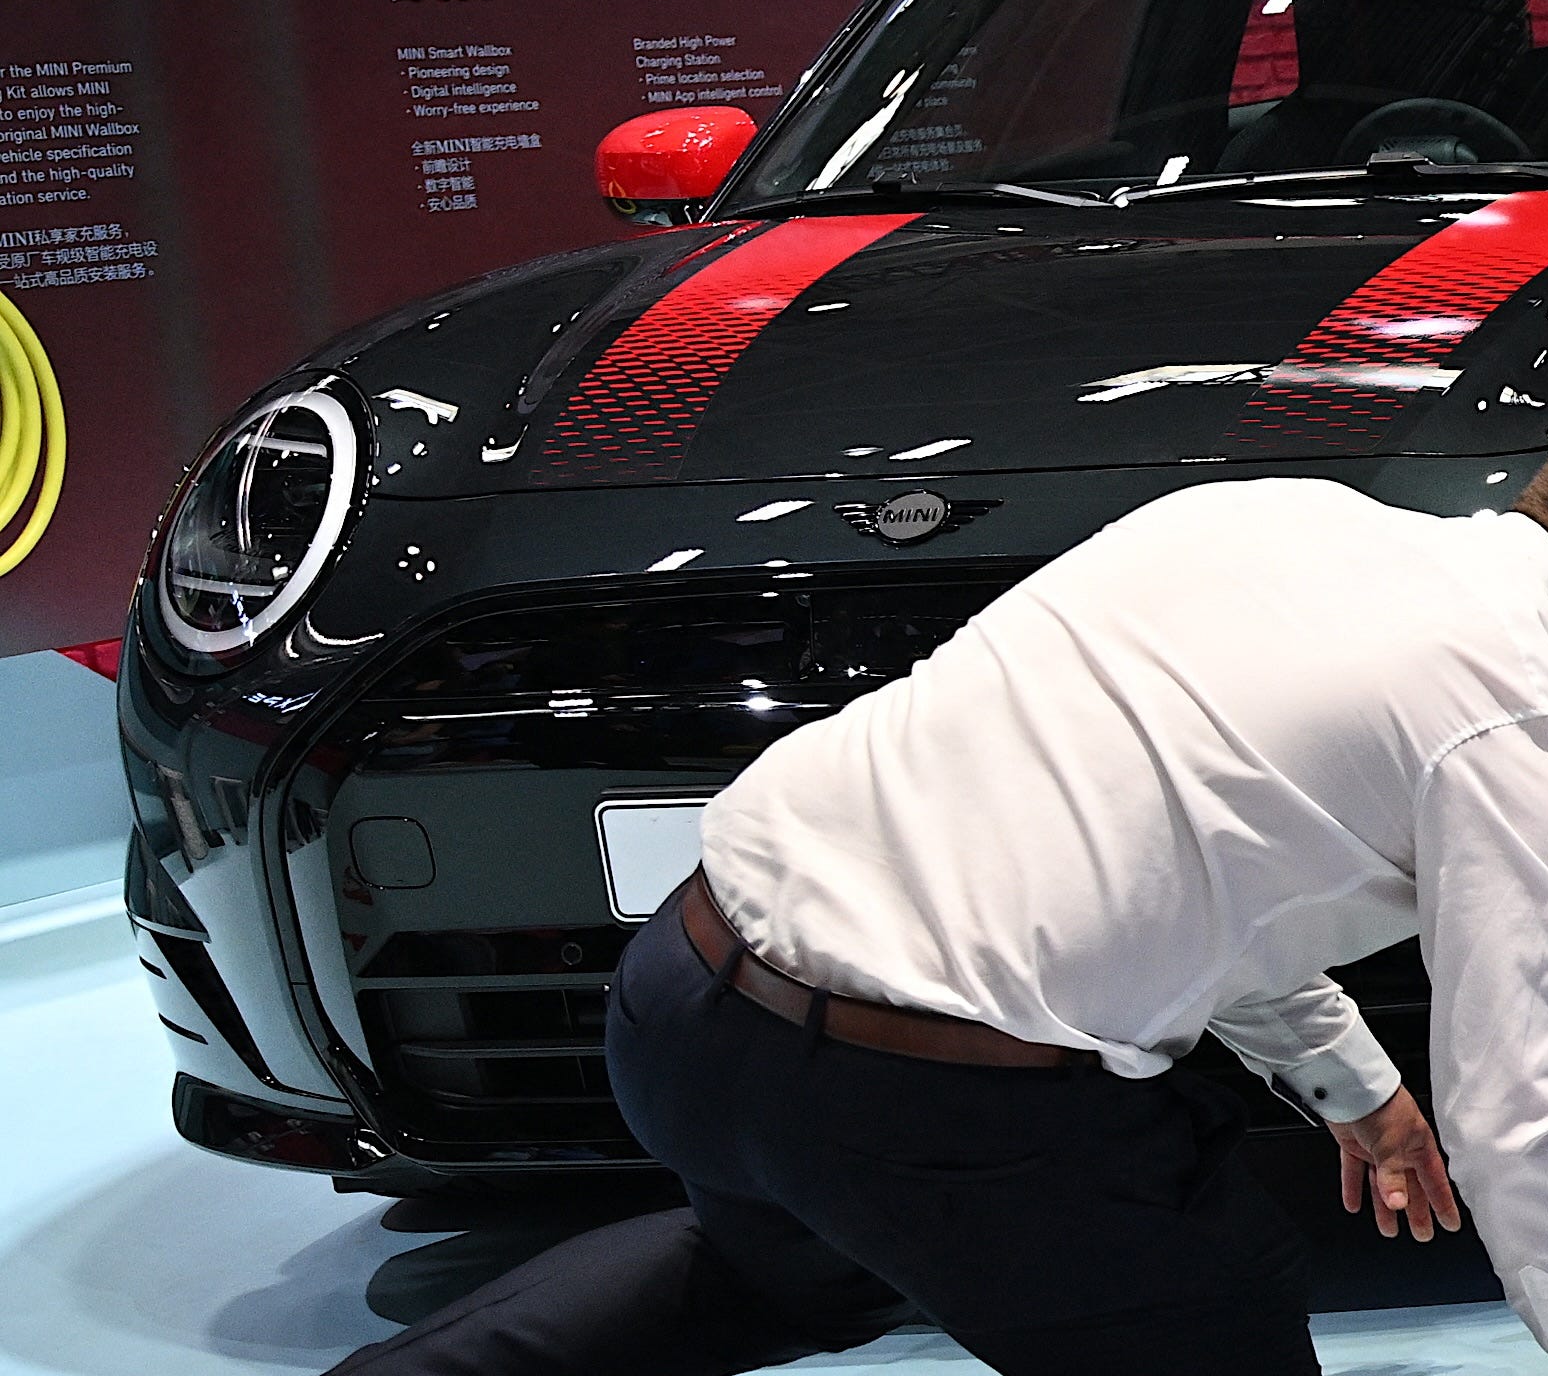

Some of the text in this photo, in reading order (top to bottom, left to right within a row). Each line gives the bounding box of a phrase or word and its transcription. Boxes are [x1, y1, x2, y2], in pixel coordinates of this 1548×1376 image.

[633, 34, 737, 51] Branded High Power
[397, 44, 513, 61] MINI Smart Wallbox
[635, 53, 722, 70] Charging Station
[9, 63, 32, 78] the
[36, 62, 68, 77] MINI
[72, 60, 133, 75] Premium
[408, 63, 510, 80] Pioneering design
[645, 68, 765, 85] Prime location selection
[6, 81, 111, 99] Kit allows MINI
[411, 82, 517, 101] Digital intelligence
[17, 106, 56, 123] enjoy
[59, 103, 83, 118] the
[86, 101, 124, 119] high-
[412, 99, 540, 119] Worry-free experience
[50, 124, 83, 139] MINI
[86, 122, 140, 137] Wallbox
[46, 143, 133, 163] specification
[21, 167, 46, 183] the
[49, 162, 135, 185] high-quality
[37, 187, 91, 203] service.
[427, 193, 478, 213] 安心品质
[882, 506, 940, 524] MINI
